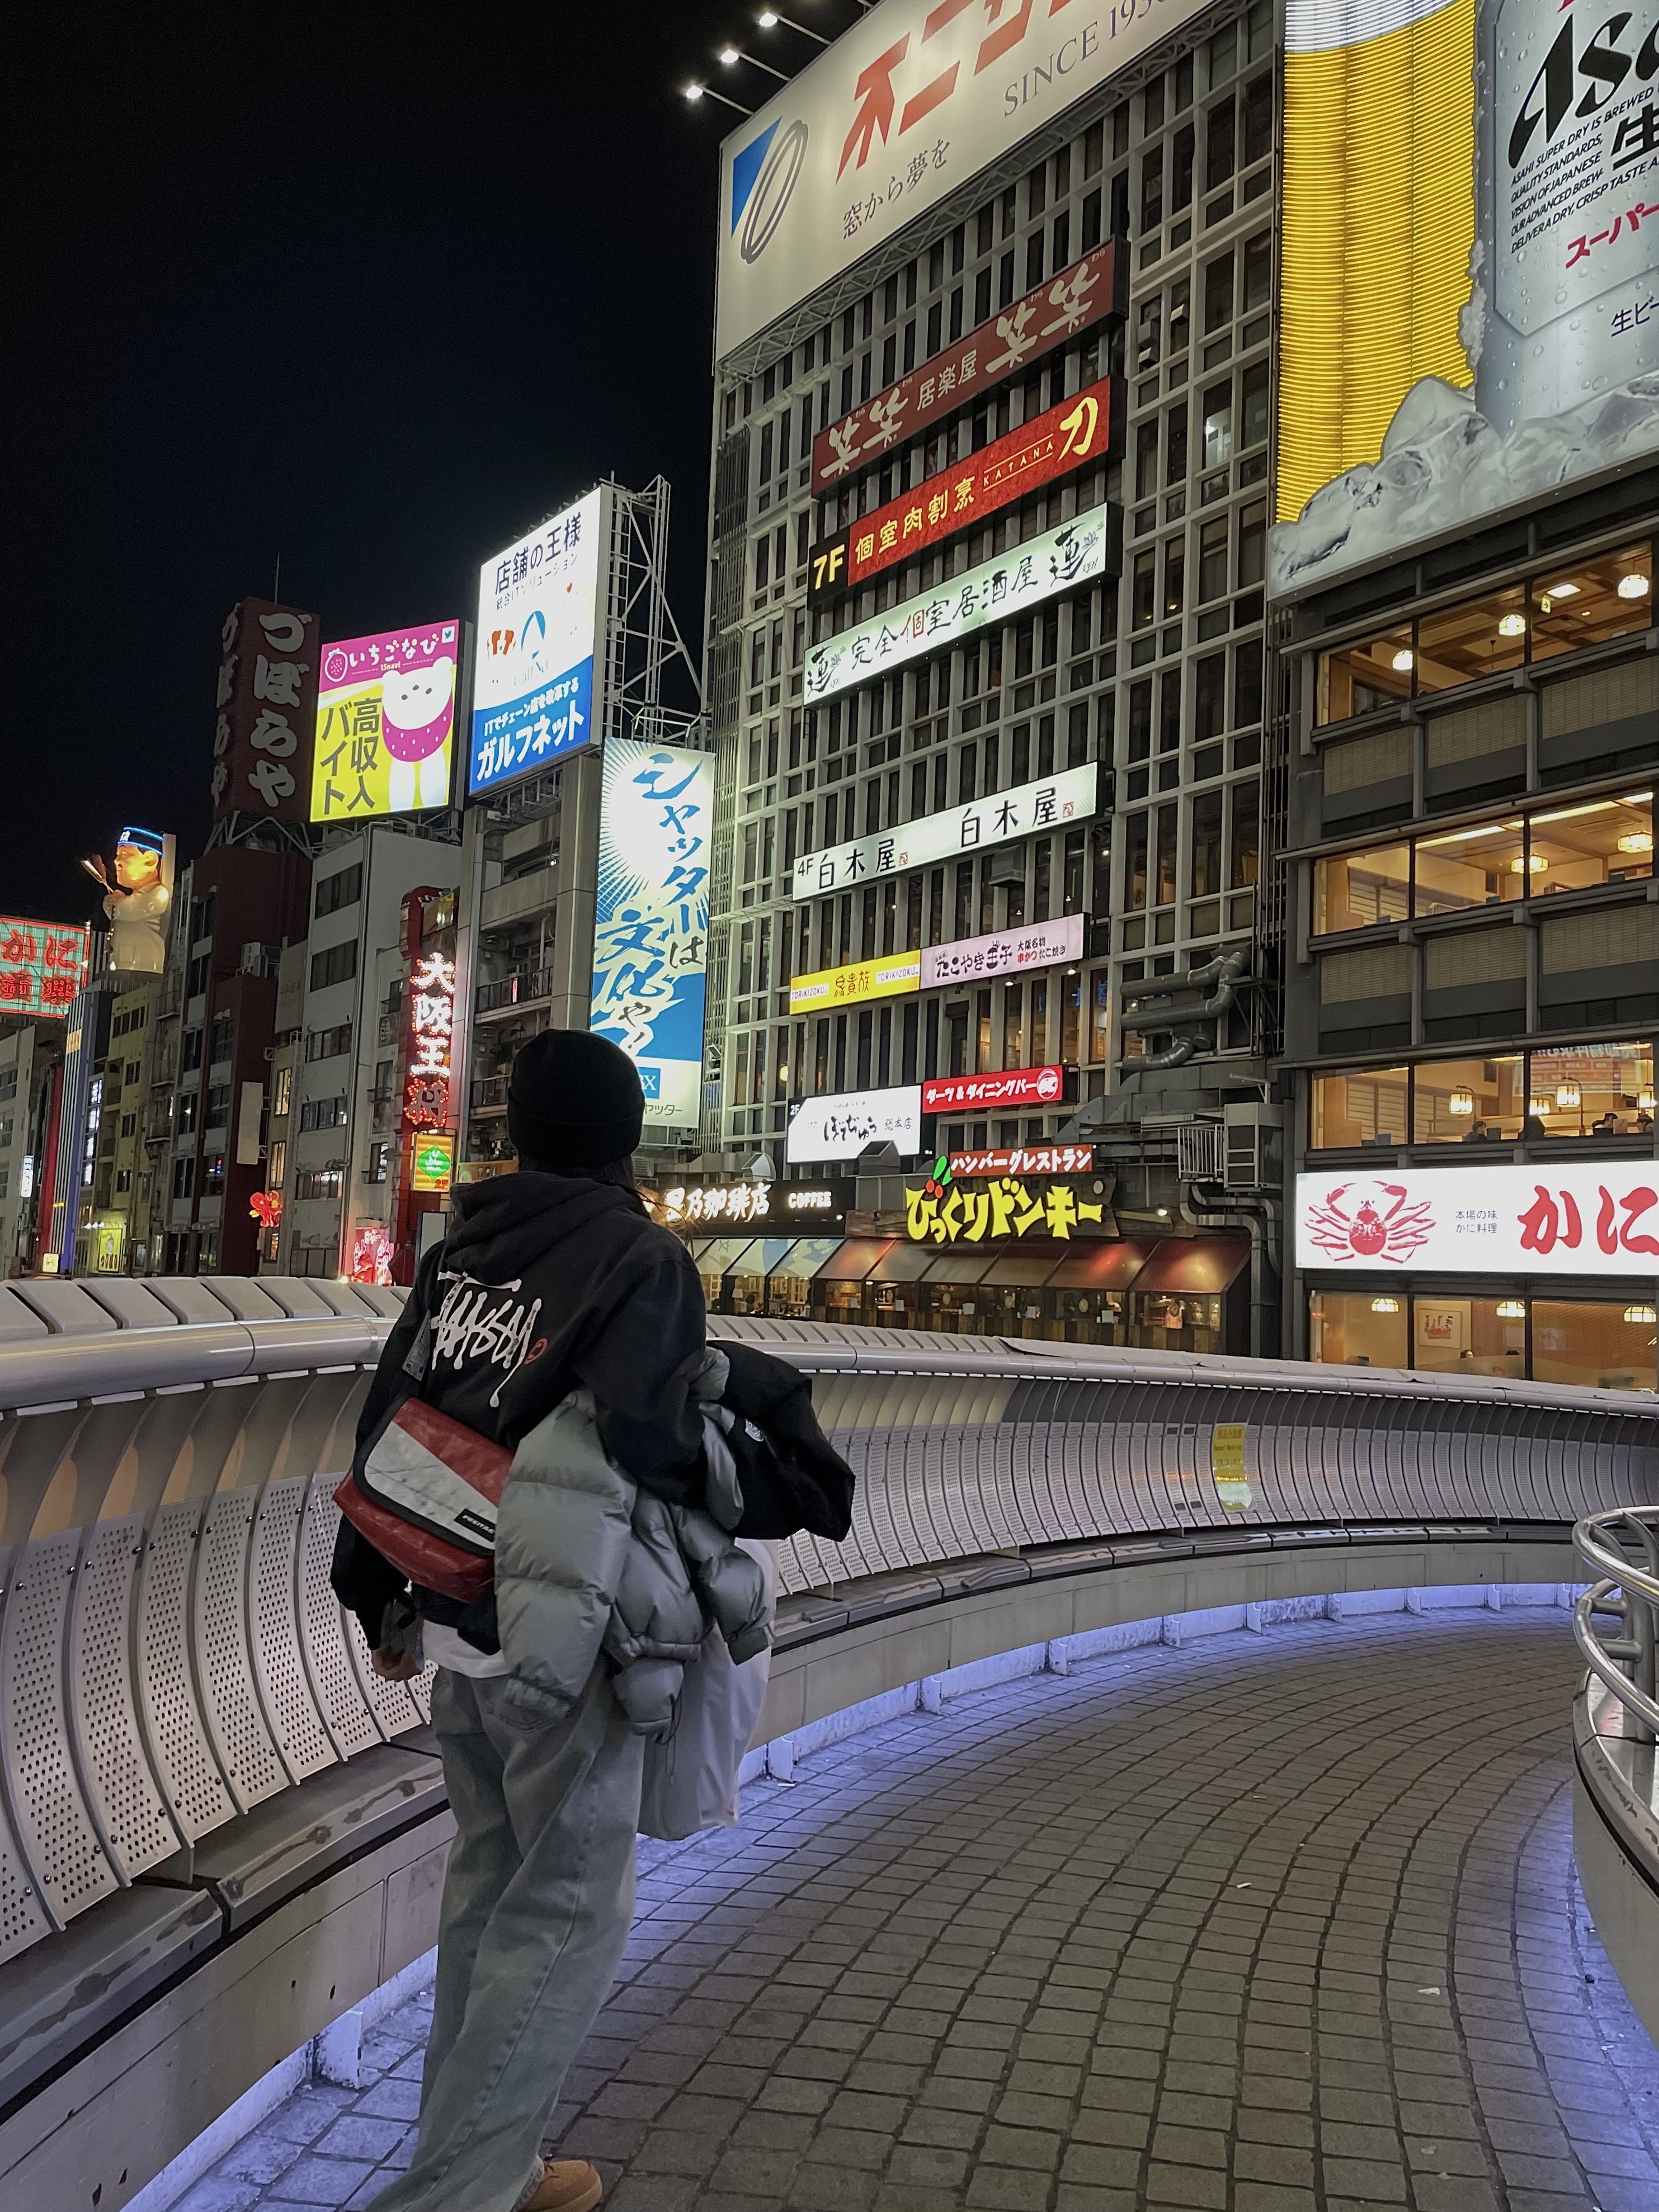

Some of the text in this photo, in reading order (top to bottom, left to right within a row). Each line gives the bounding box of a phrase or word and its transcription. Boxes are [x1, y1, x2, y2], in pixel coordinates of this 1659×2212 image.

[1003, 20, 1099, 119] SINCE
[1511, 86, 1654, 187] ASAHI SUPER DRY IS BREWED
[1511, 133, 1603, 204] QUALITY STANDARDS,
[843, 139, 951, 240] 窓から夢を
[1511, 150, 1603, 220] VISION OF JAPANESE
[1511, 221, 1547, 254] DELIVER
[1552, 201, 1576, 224] DRY,
[1575, 183, 1609, 210] CRISP
[1609, 161, 1649, 191] TASTE
[1511, 218, 1528, 237] OUR
[1526, 190, 1573, 228] ADVANCED
[917, 349, 978, 411] 居楽屋
[814, 396, 1099, 590] 7F 個室肉割烹 KATANA 刀
[494, 512, 581, 595] 店舗の王様
[852, 555, 1038, 670] 完全個室居酒屋
[349, 633, 440, 668] いちごなび
[248, 612, 313, 807] づぼらや
[477, 699, 585, 781] ガルフネット
[321, 701, 352, 815] バイト
[347, 697, 382, 812] 高収入
[633, 752, 709, 969] シャッターは
[798, 787, 1058, 889] 4F 白木屋 白木屋
[936, 941, 1012, 978] たこやき王子
[1017, 936, 1046, 952] 大阪名物
[791, 967, 915, 999] TORIKIZOKU 鳥貴族 TORIKIZOKU
[790, 1104, 800, 1115] 2F
[884, 1116, 912, 1131] 総本店
[433, 1178, 449, 1189] 2F
[951, 1148, 1091, 1174] ハンバーグレストラン
[666, 1182, 832, 1221] 星乃珈琲店 COFFEE
[905, 1177, 1102, 1243] びっくりドンキー
[1455, 1209, 1497, 1220] 本場の味
[1455, 1223, 1497, 1234] かに料理
[1517, 1185, 1659, 1256] かに
[463, 1515, 495, 1534] FREITAG
